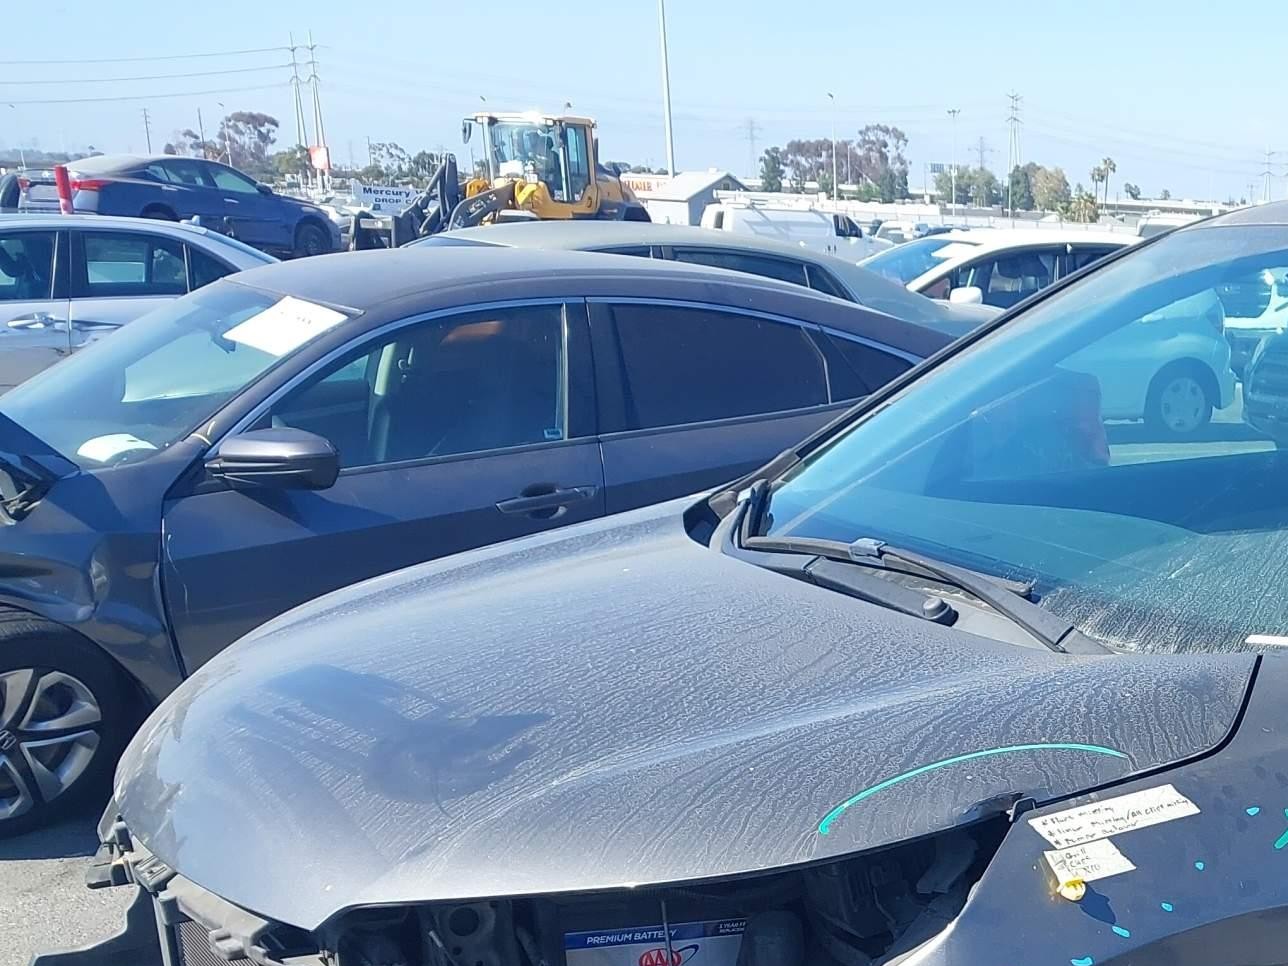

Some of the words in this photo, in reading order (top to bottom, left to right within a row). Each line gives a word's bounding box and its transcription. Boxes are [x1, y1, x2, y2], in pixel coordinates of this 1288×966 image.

[362, 186, 411, 198] Mercury
[586, 934, 632, 945] PREMIUM
[634, 929, 677, 941] BATTEY
